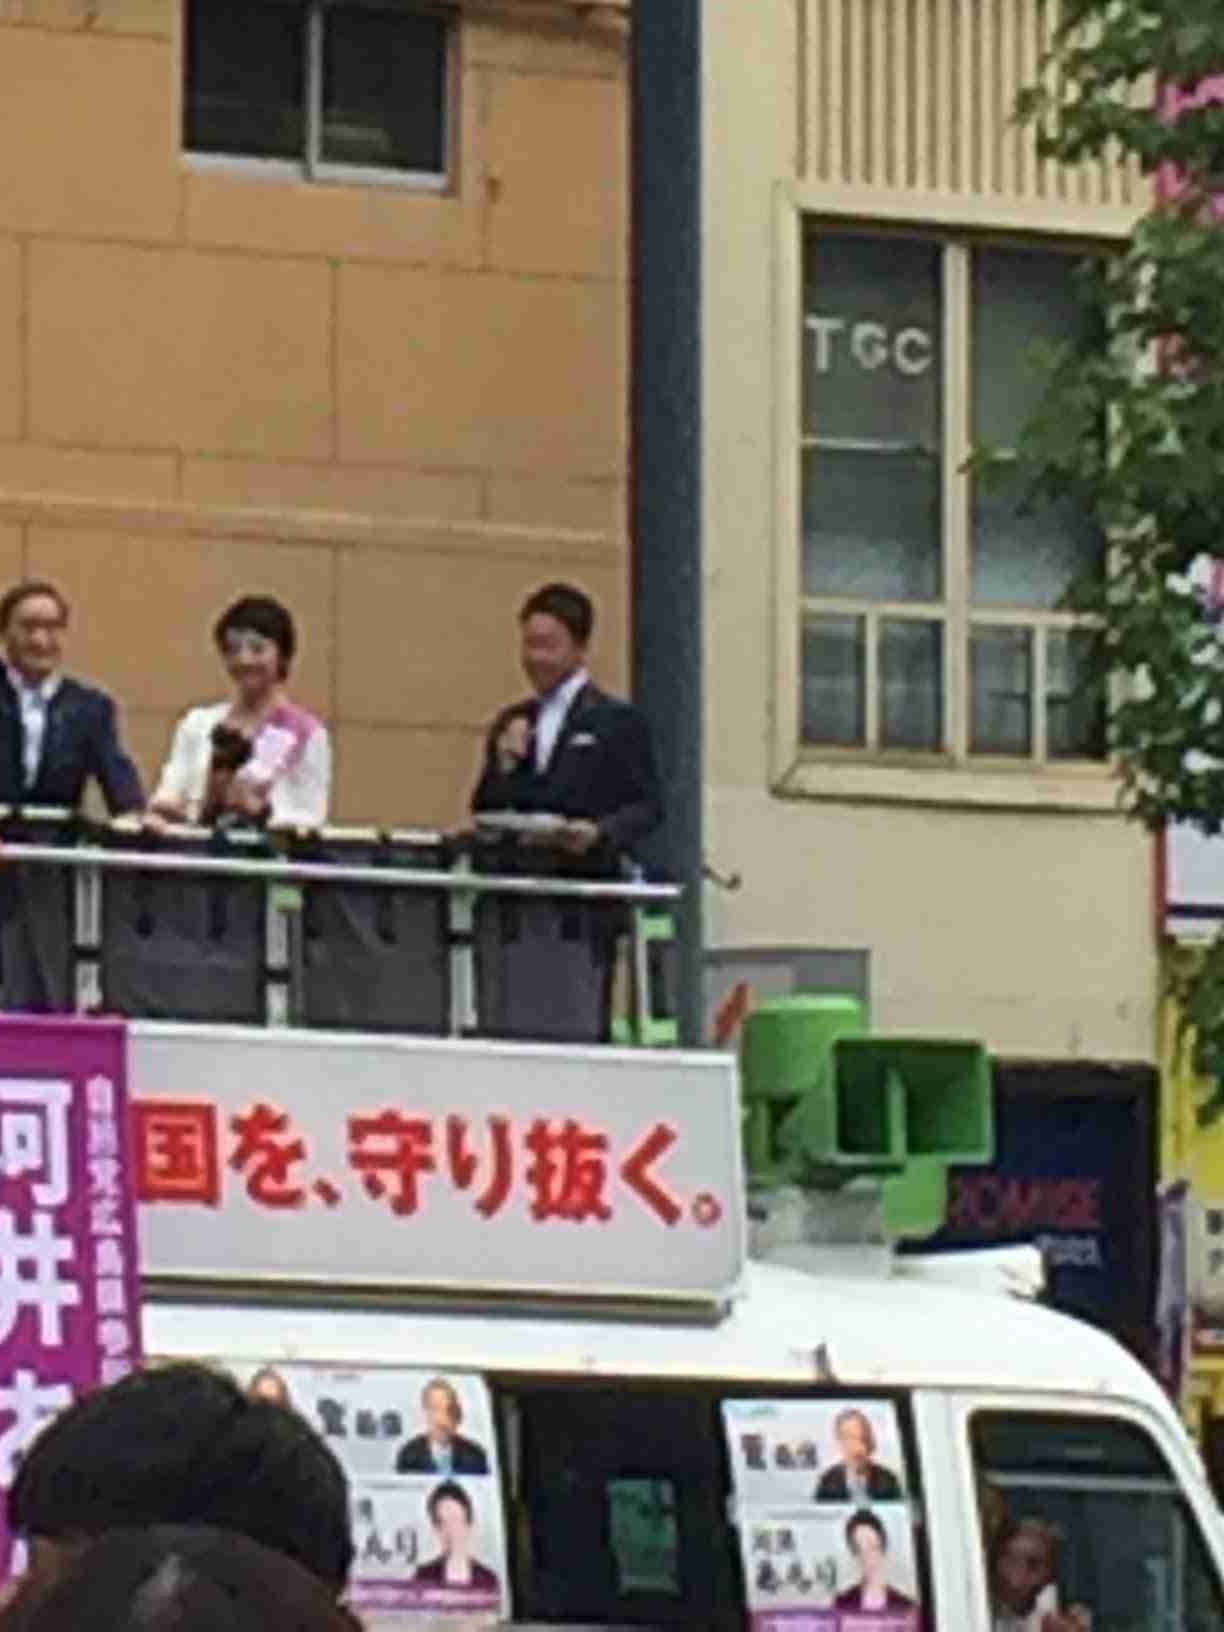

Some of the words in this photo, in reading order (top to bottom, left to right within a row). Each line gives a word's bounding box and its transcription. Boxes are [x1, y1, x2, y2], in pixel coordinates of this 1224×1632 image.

[128, 1100, 724, 1228] 国を、守り抜く。
